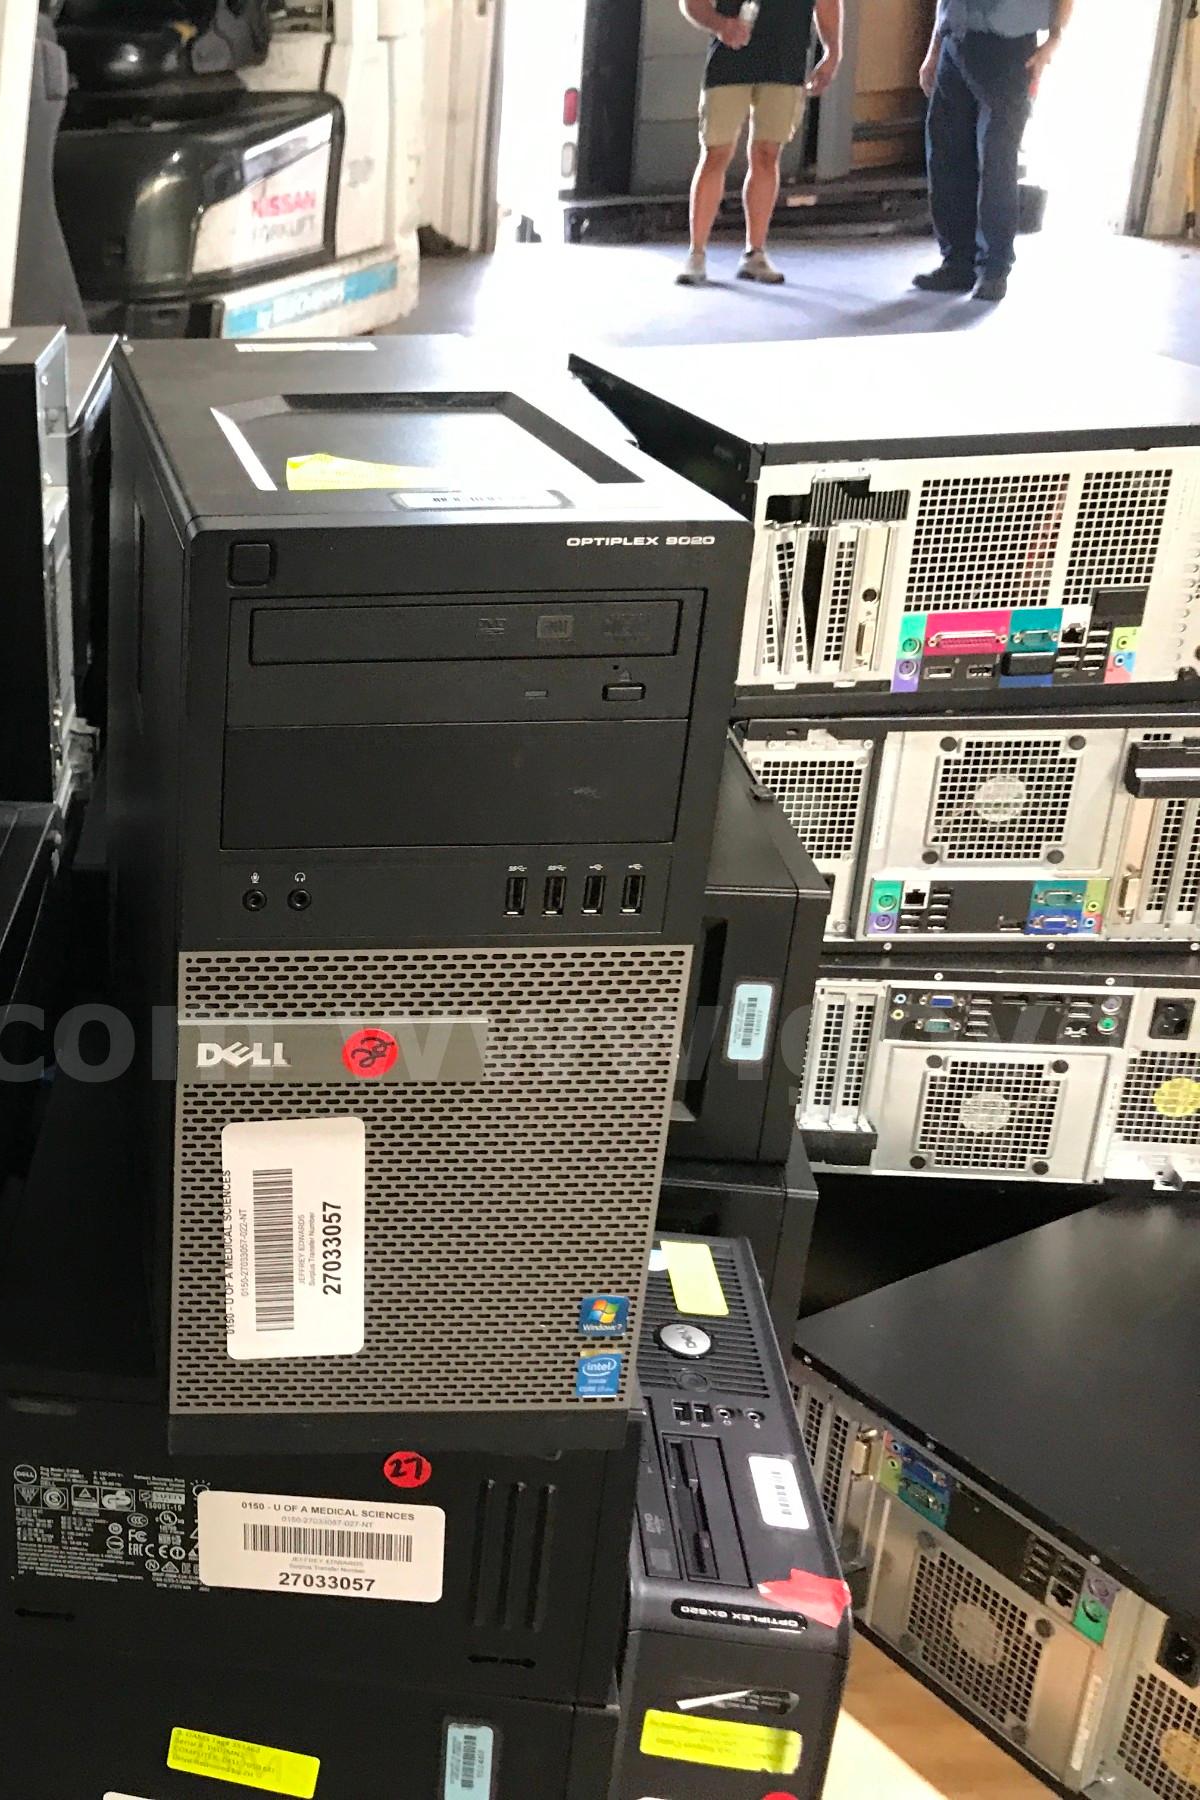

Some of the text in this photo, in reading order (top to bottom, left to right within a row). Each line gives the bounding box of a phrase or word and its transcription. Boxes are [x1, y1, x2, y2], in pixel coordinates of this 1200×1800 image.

[566, 535, 716, 547] OPTIPLEX 9020
[196, 1041, 292, 1067] DELL
[221, 1170, 232, 1221] SCIENCES
[223, 1223, 233, 1268] MEDICAL
[322, 1201, 342, 1296] 27033057
[582, 1323, 616, 1332] Windows
[587, 1361, 612, 1372] intel
[388, 1456, 423, 1480] 27
[241, 1501, 265, 1511] 0150
[273, 1504, 281, 1512] U
[284, 1504, 298, 1513] OF
[301, 1505, 308, 1514] A
[311, 1506, 359, 1517] MEDICAL
[361, 1510, 415, 1521] SCIENCES
[278, 1572, 376, 1593] 27033057
[731, 1611, 799, 1628] OPTIPLEX
